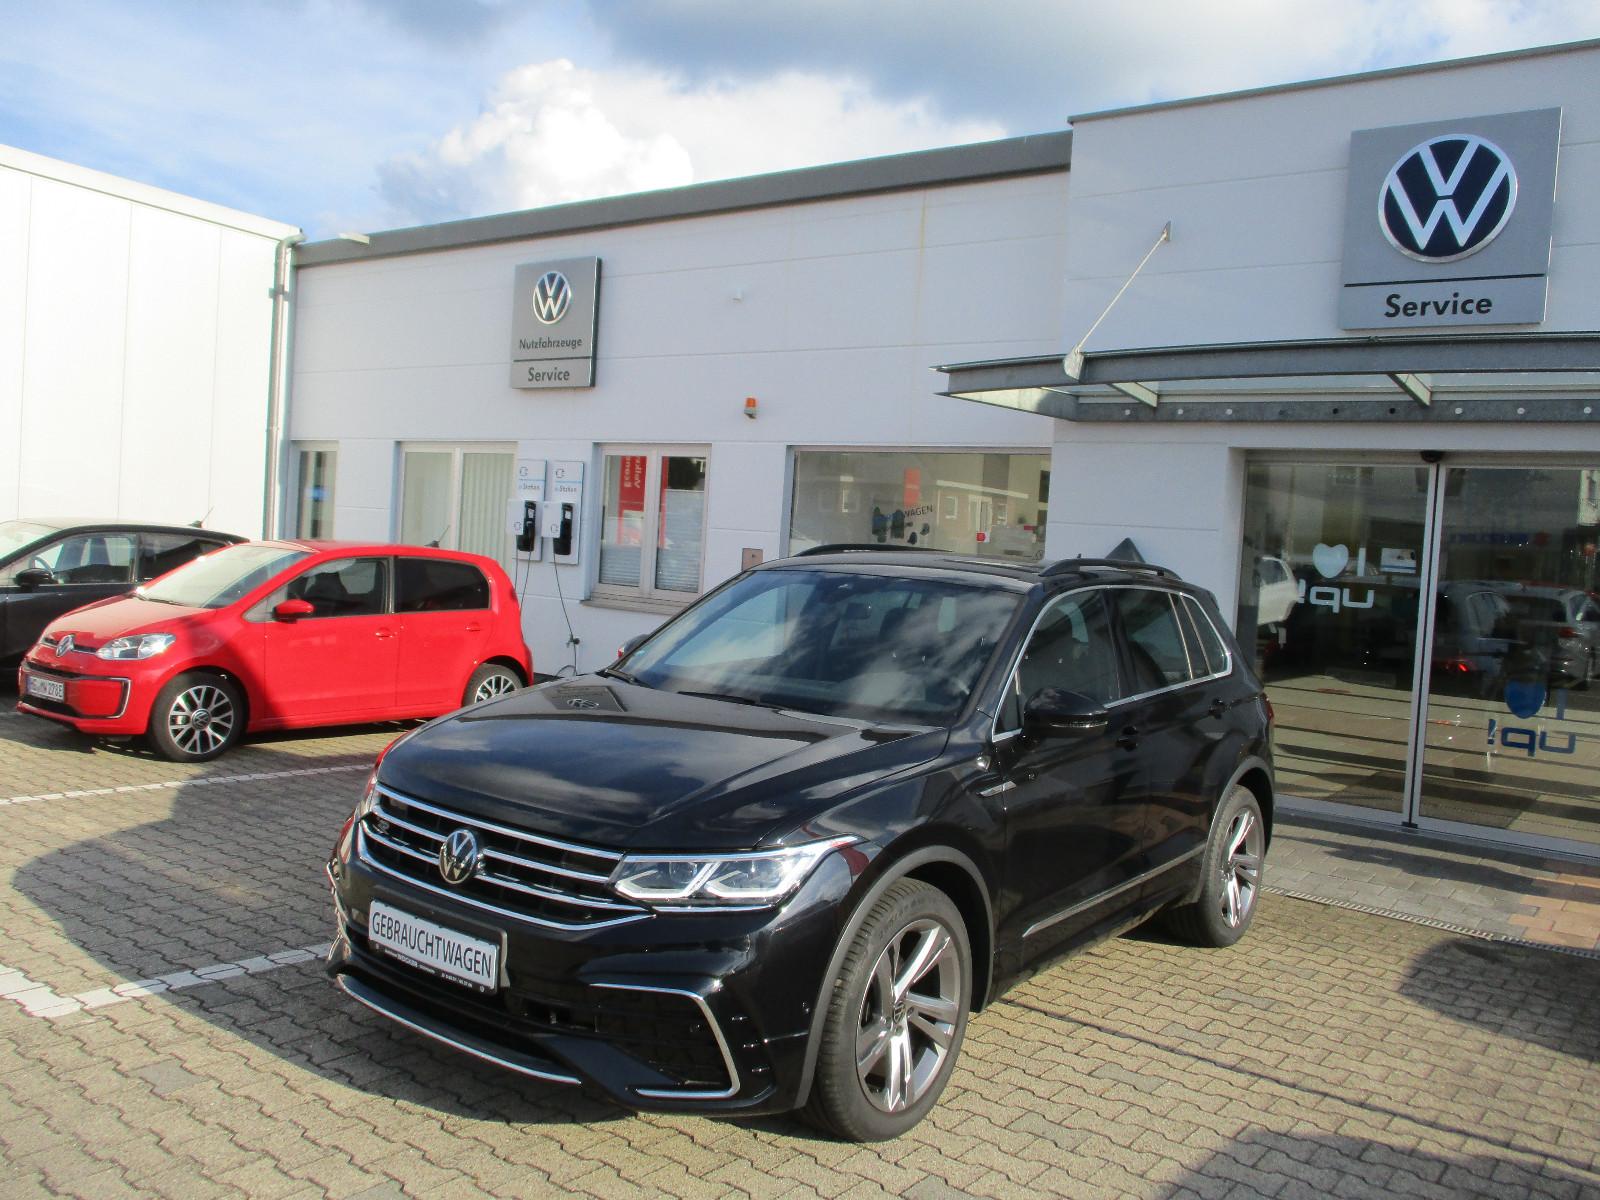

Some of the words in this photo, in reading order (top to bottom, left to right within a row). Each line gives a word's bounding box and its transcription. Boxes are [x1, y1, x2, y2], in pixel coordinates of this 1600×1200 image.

[1384, 292, 1493, 318] Service
[519, 337, 583, 350] Nutzfahrzeuge
[527, 366, 570, 382] Service
[372, 911, 492, 979] GEBRAUCHTWAGEN
